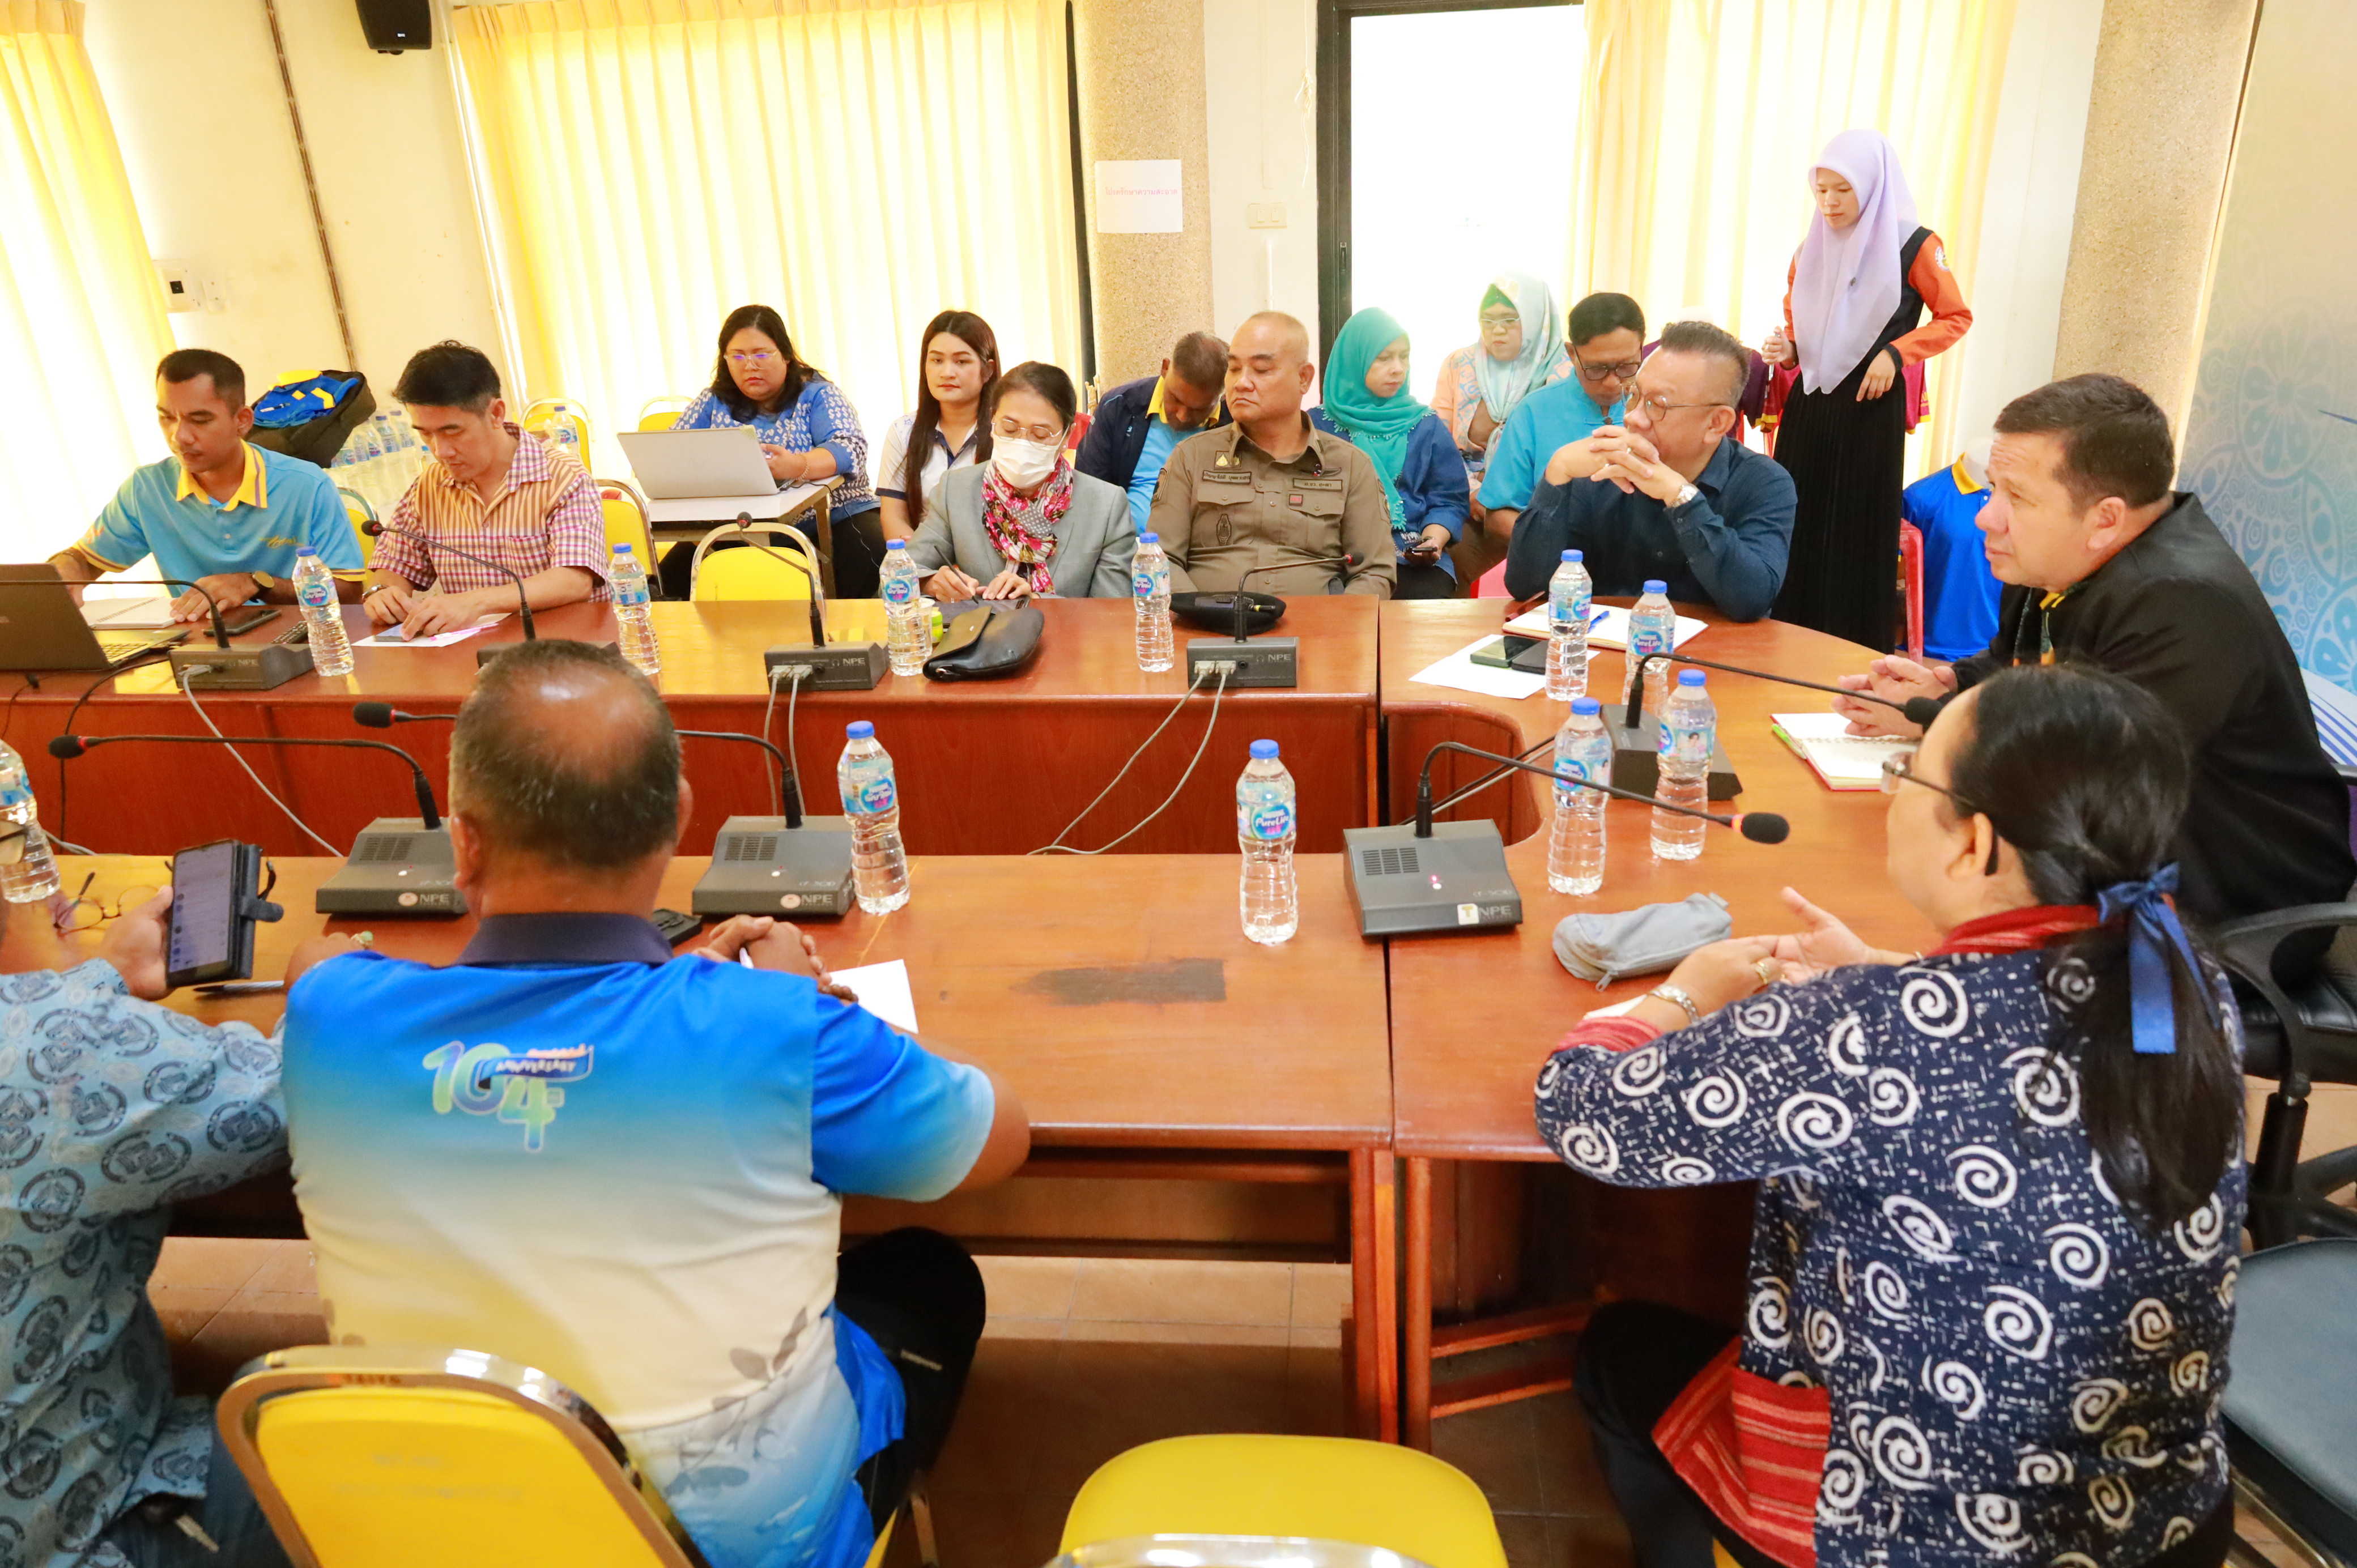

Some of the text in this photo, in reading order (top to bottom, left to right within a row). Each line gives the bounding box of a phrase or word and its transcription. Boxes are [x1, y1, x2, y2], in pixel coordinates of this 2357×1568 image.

[419, 893, 449, 903] NPE
[801, 894, 833, 903] NPE
[1479, 905, 1511, 916] NPE
